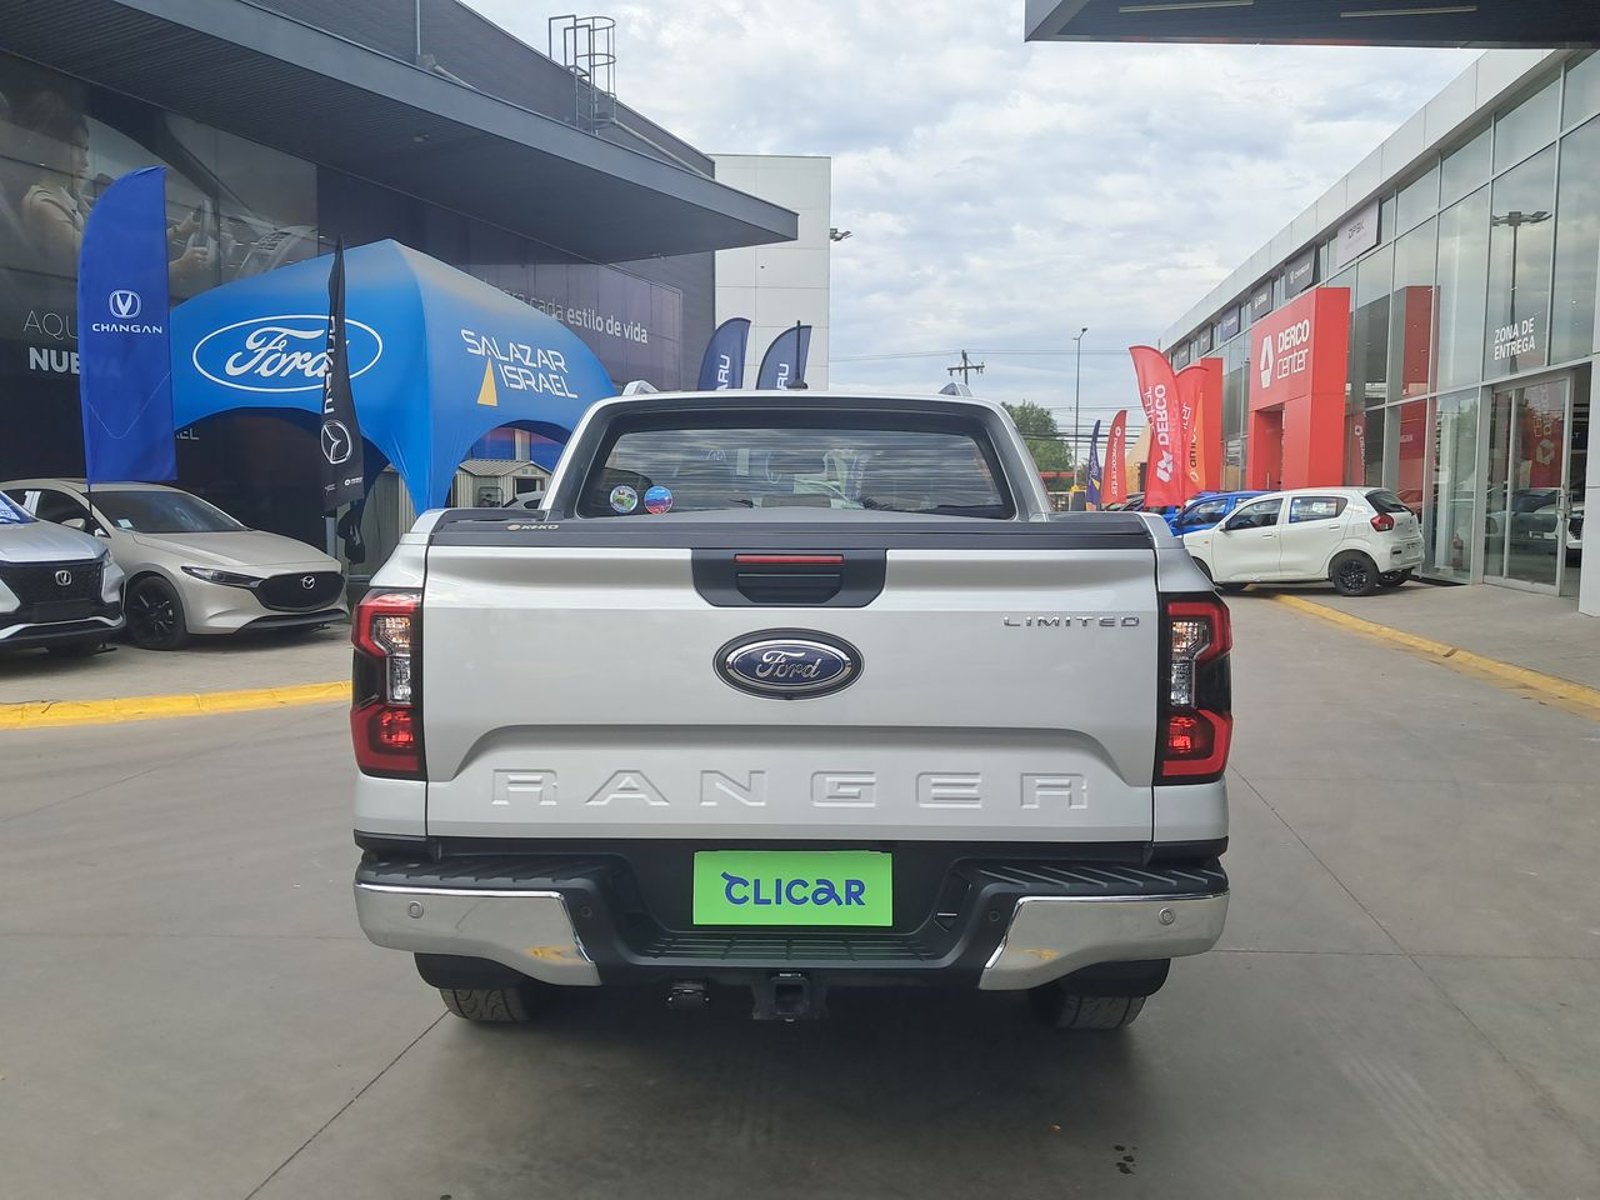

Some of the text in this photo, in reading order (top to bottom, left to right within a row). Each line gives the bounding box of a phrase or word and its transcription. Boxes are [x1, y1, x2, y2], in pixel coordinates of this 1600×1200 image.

[92, 323, 163, 334] CHANGAN
[567, 308, 604, 332] estilo
[606, 314, 621, 337] de
[623, 321, 648, 343] vida
[1278, 319, 1310, 354] DERCO
[1494, 317, 1535, 344] ZONA DE
[460, 329, 568, 373] SALAZAR
[1494, 335, 1536, 361] ENTREGA
[498, 363, 578, 399] ISRAEL
[1003, 615, 1140, 627] LIMITED
[756, 650, 822, 678] Ford
[492, 769, 1089, 810] RANGER
